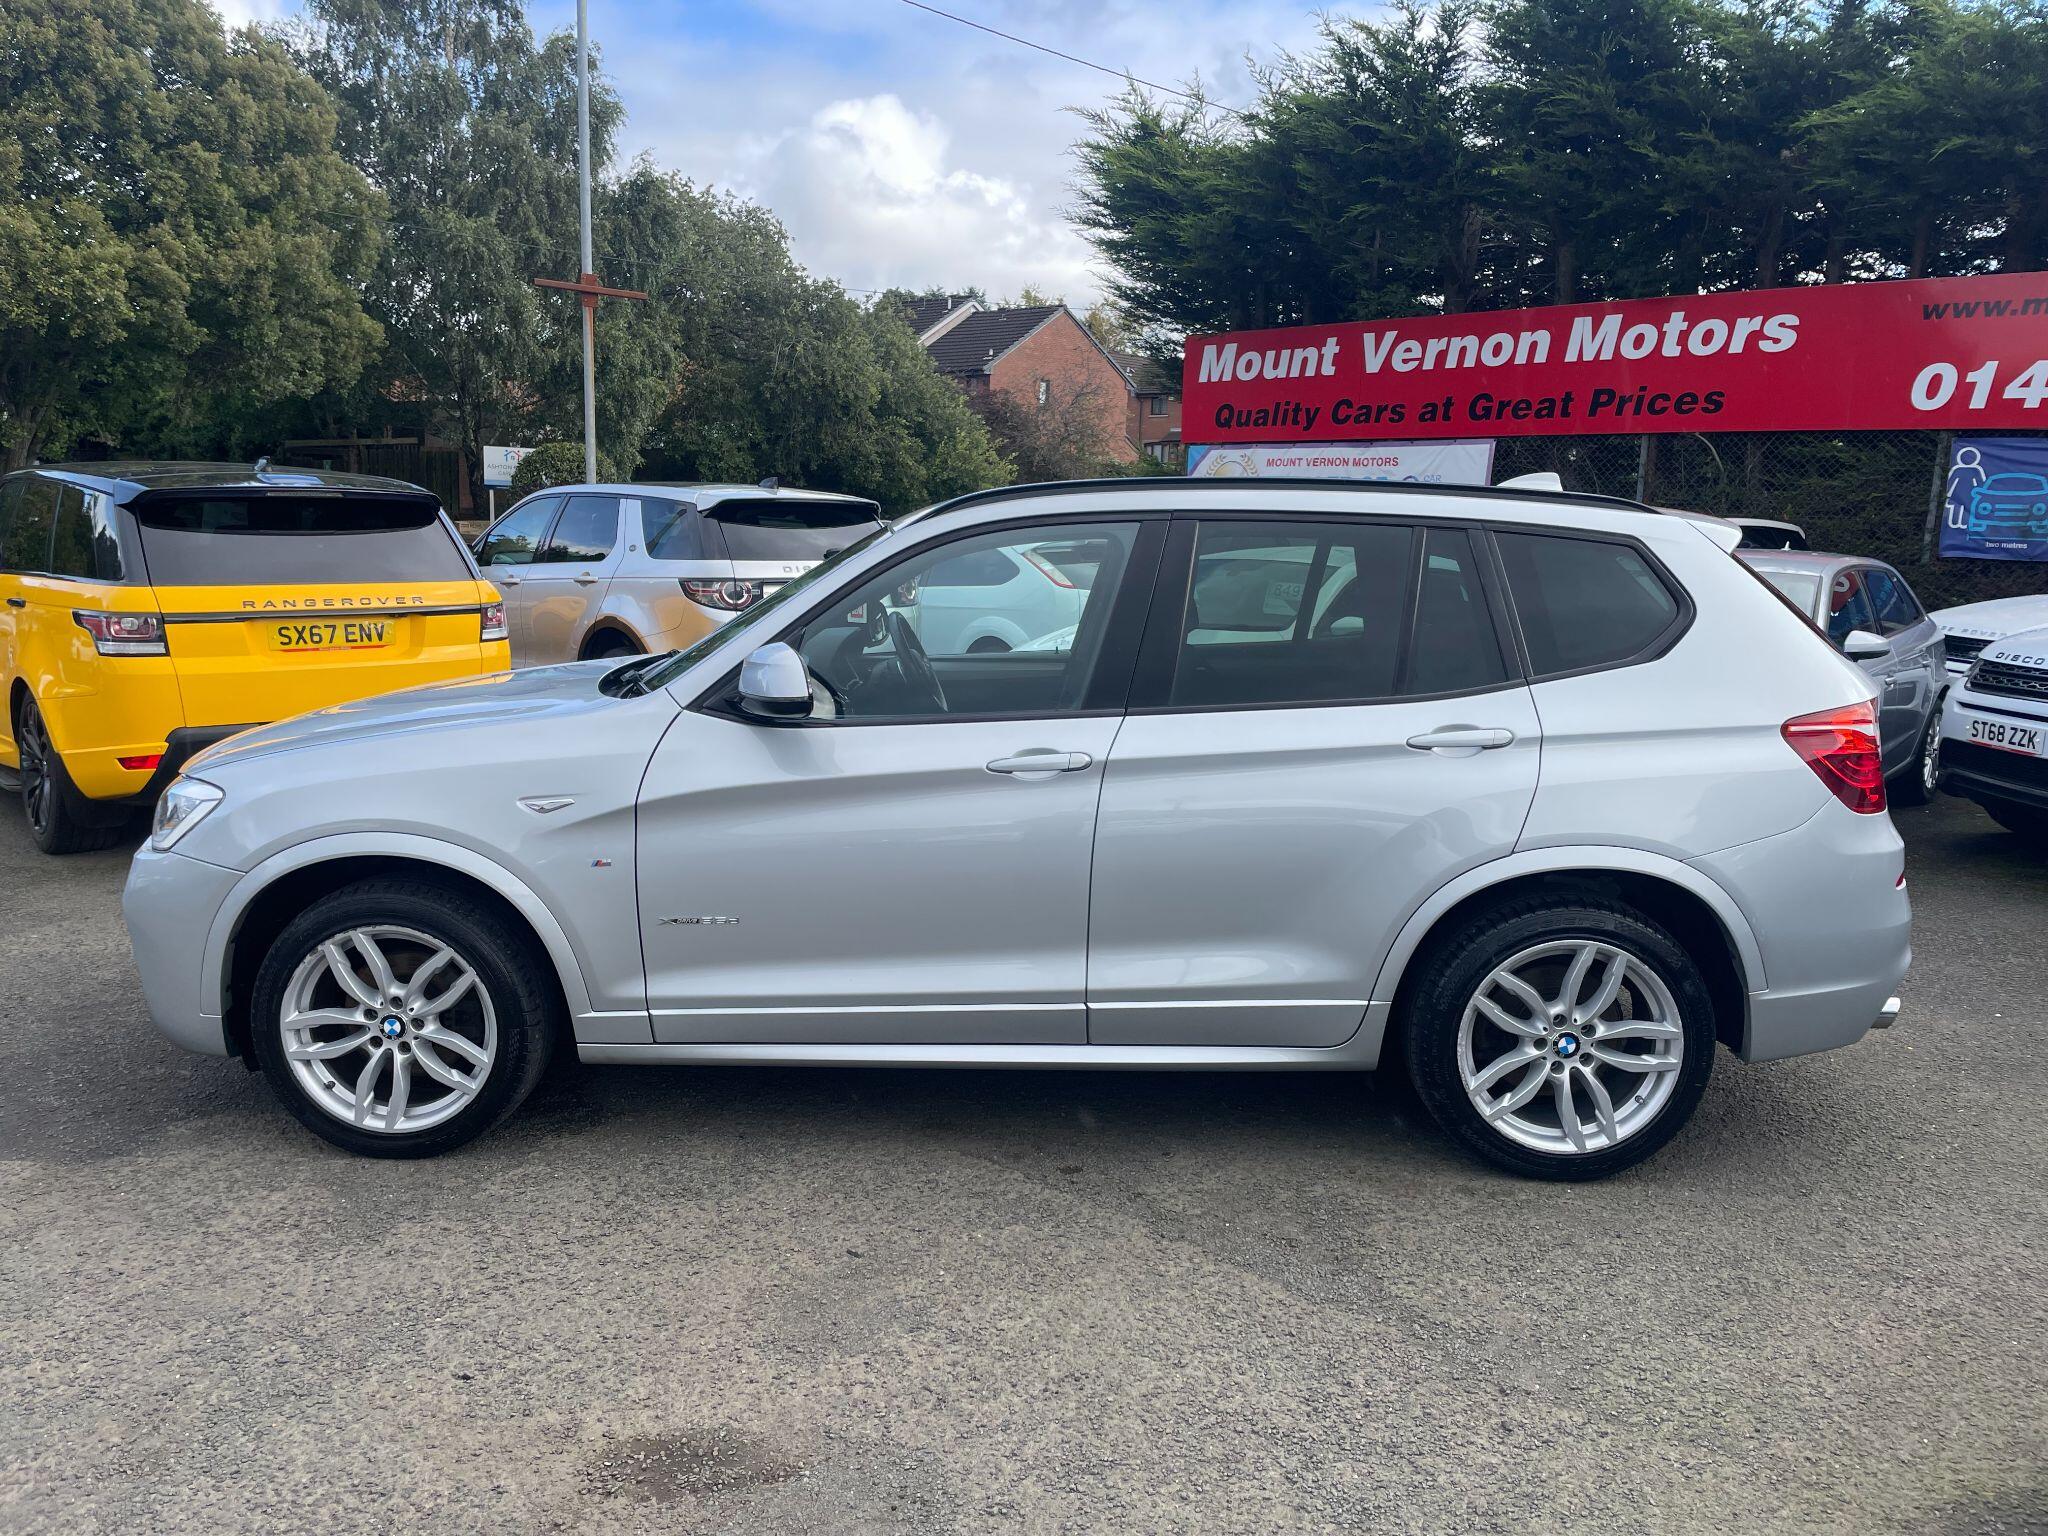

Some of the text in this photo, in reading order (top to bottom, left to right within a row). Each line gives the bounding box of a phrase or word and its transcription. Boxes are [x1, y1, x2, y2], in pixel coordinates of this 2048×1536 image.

[1198, 311, 1800, 383] Mount Vernon Motors
[1911, 360, 2048, 411] 014
[1214, 385, 1725, 431] Quality Cars at Great Prices
[1266, 456, 1399, 467] MOUNT VERNON MOTORS
[278, 623, 385, 646] SX67 ENV
[1971, 720, 2038, 750] ST68 ZZK
